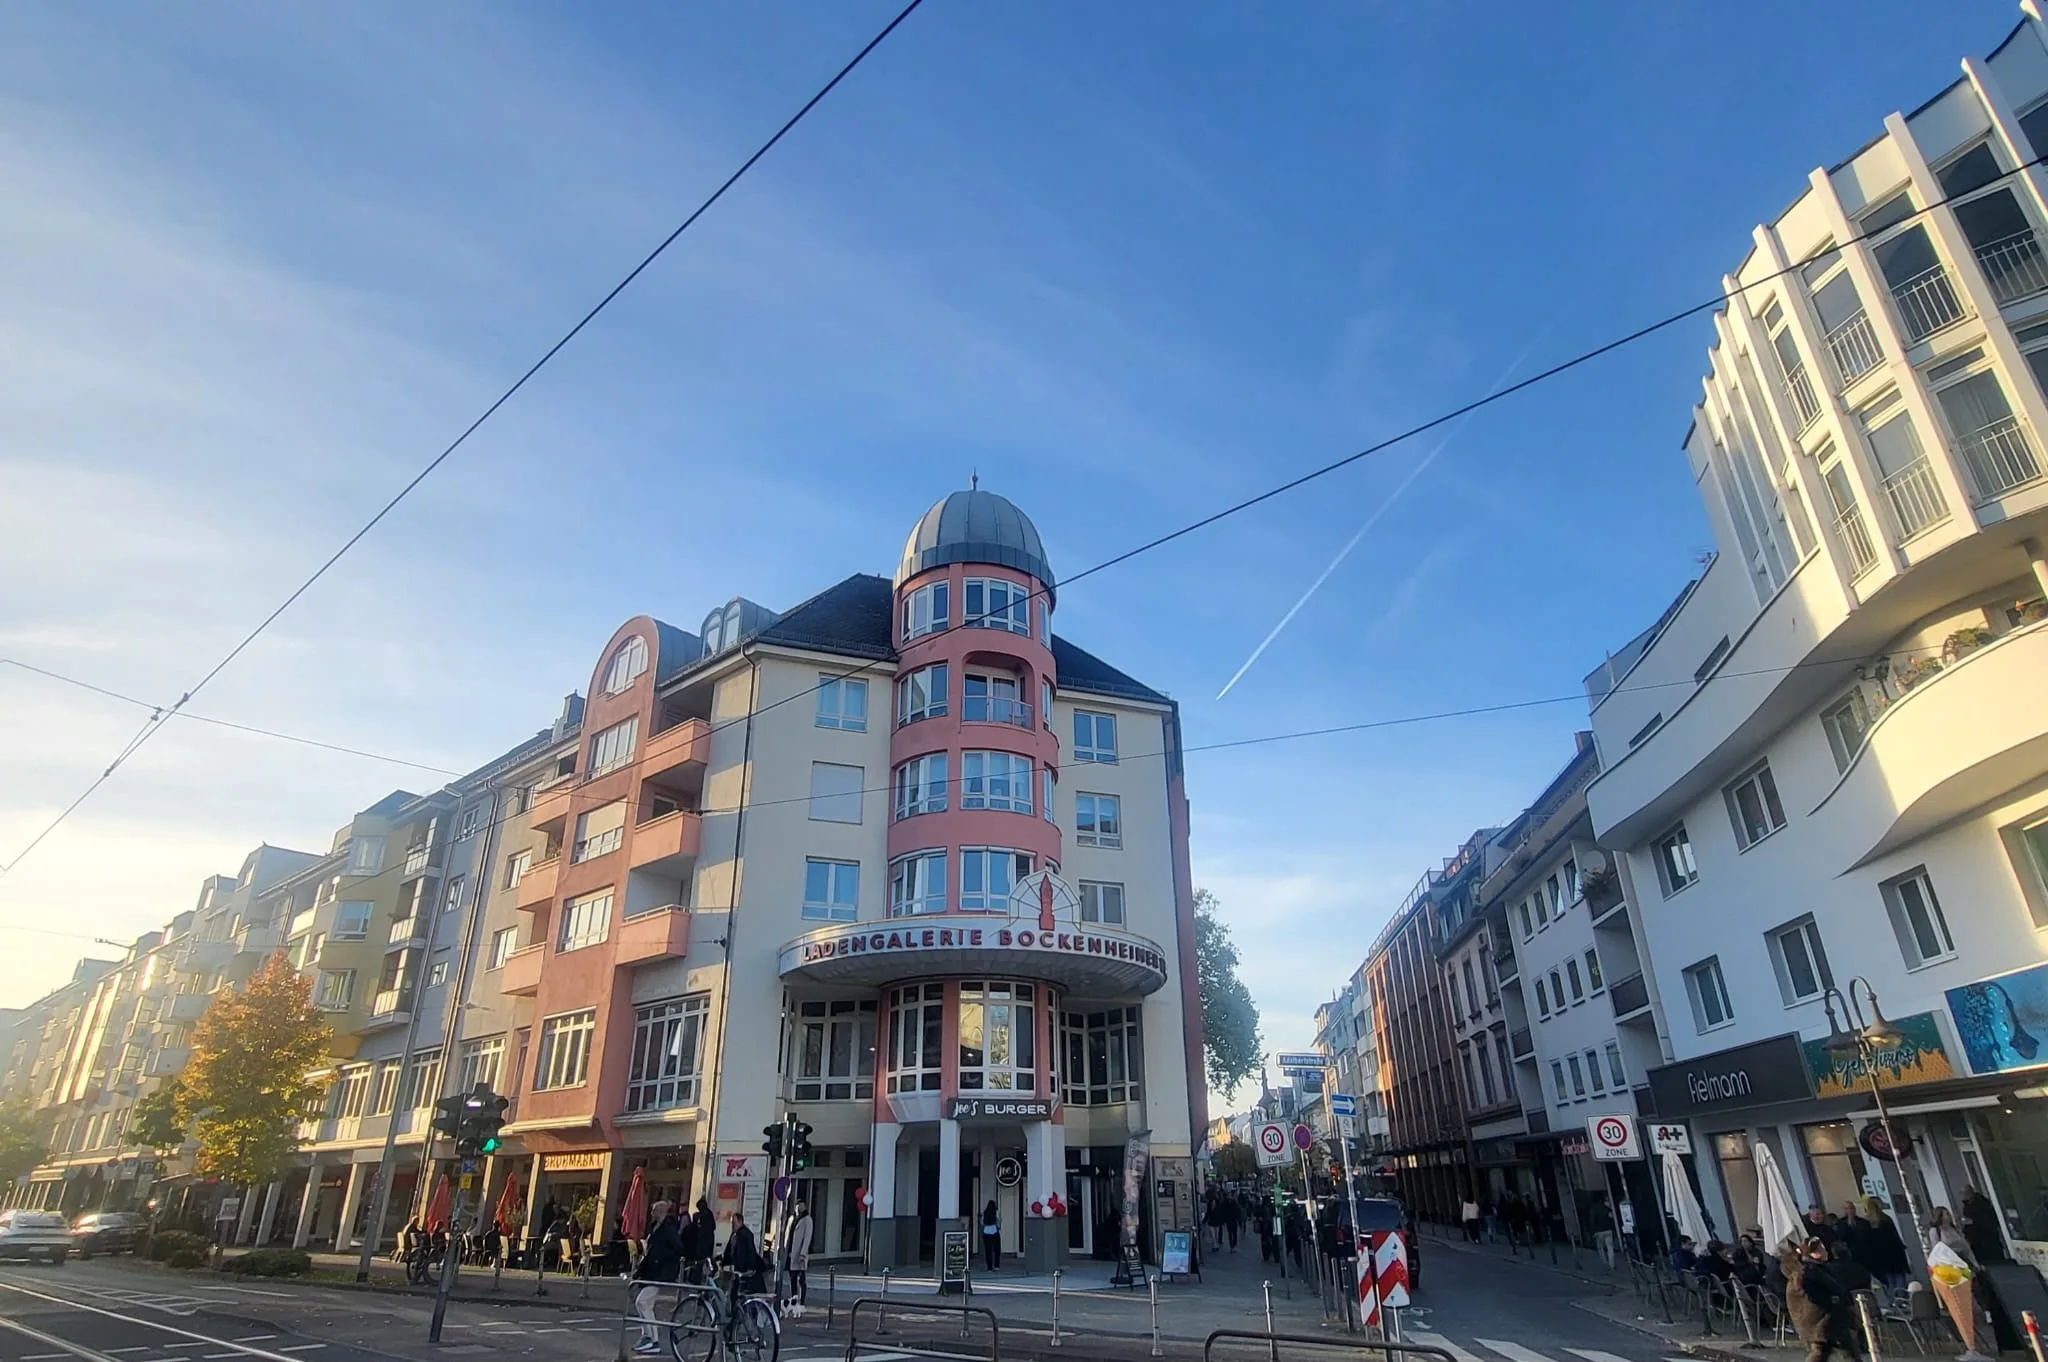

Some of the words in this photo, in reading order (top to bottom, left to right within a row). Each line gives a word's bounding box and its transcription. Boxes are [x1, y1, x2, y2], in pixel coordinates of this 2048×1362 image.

[804, 929, 982, 961] LADENGALERIE
[999, 929, 1159, 969] BOCKENHEIMER
[984, 1103, 1048, 1115] BURGER
[1603, 1126, 1622, 1140] 30
[1266, 1133, 1280, 1146] 30
[1267, 1153, 1285, 1163] ZONE
[1605, 1148, 1629, 1157] ZONE
